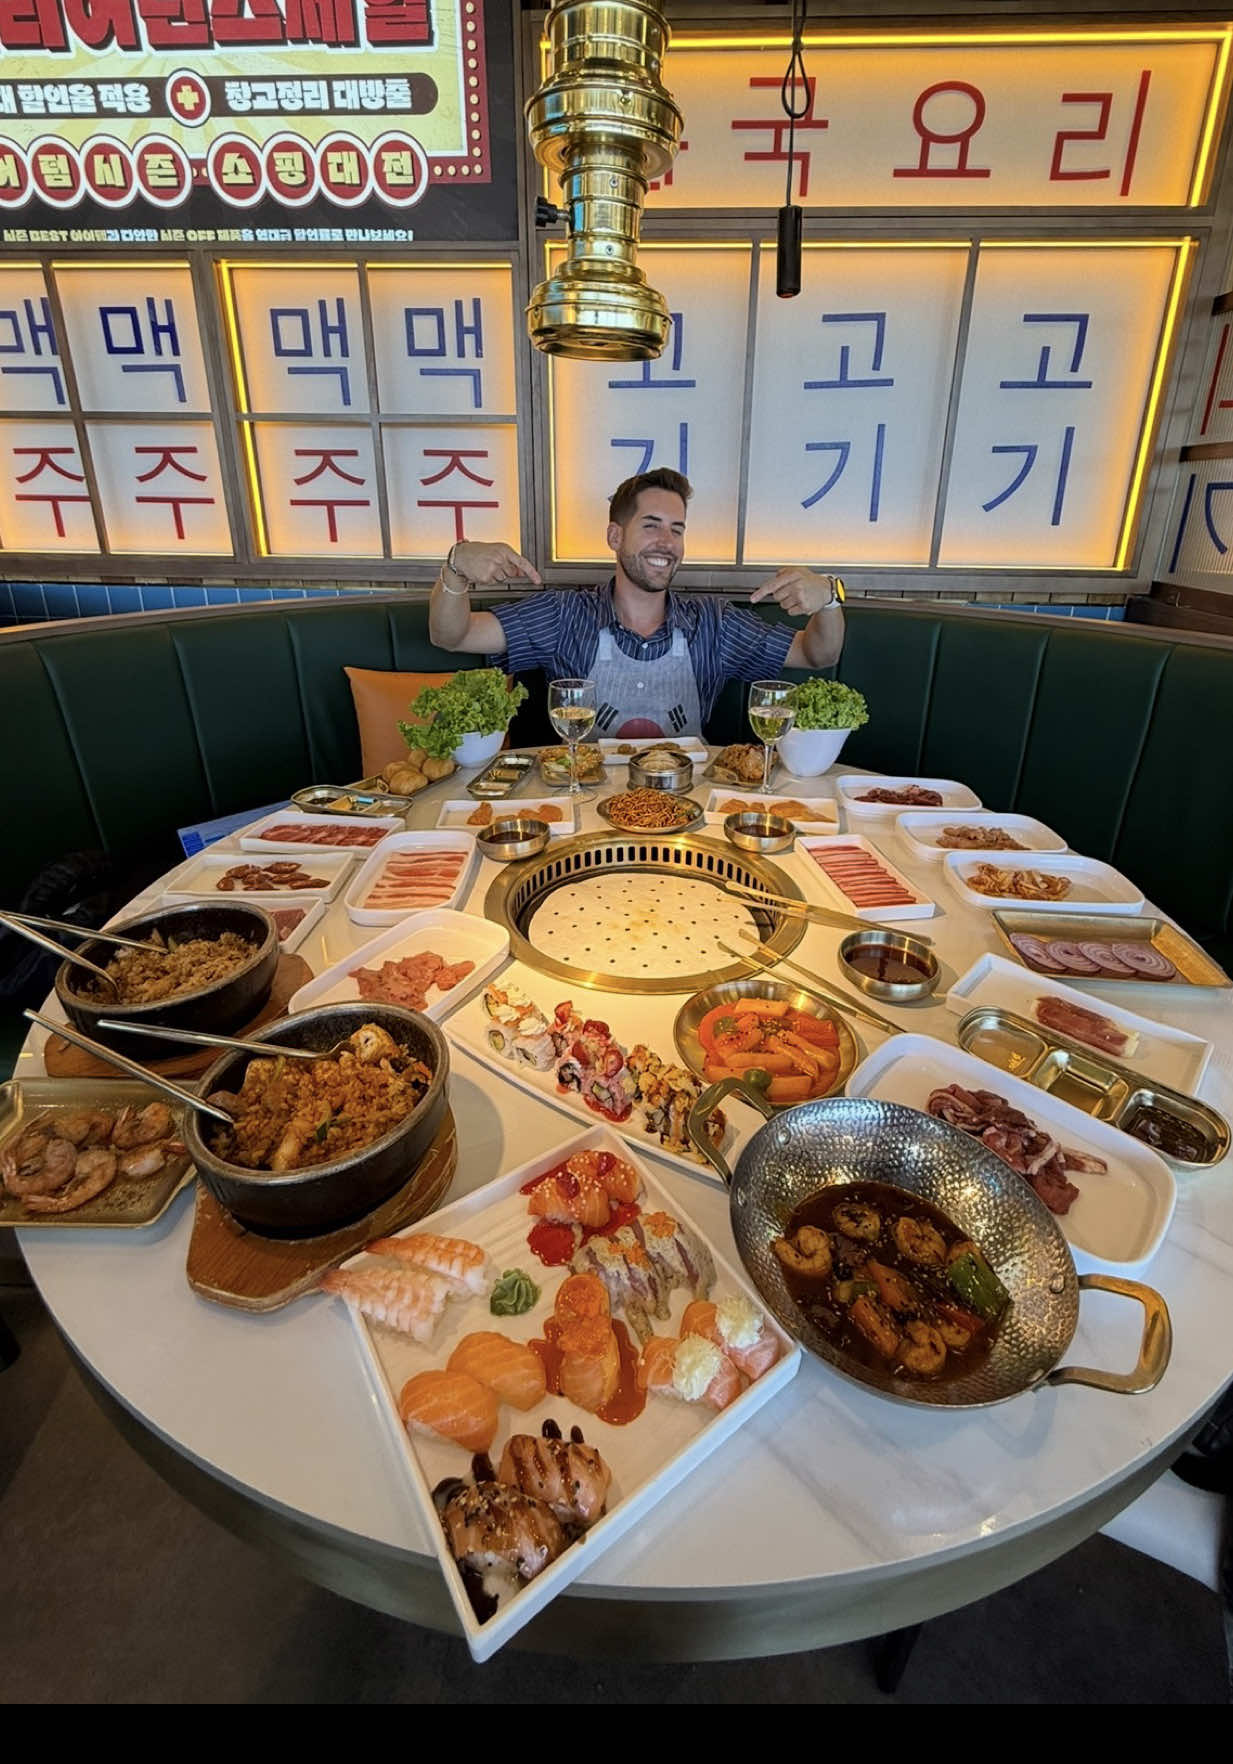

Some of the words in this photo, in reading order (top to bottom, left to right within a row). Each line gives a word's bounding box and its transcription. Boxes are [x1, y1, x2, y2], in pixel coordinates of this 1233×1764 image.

[97, 82, 152, 113] 적용
[225, 79, 330, 112] 창고정리
[332, 77, 413, 111] 대방출
[29, 229, 69, 242] BEST
[99, 296, 216, 540] 맥주
[269, 296, 371, 543] 맥주
[404, 296, 500, 542] 맥주
[801, 311, 894, 523] 고기
[982, 312, 1093, 527] 고기
